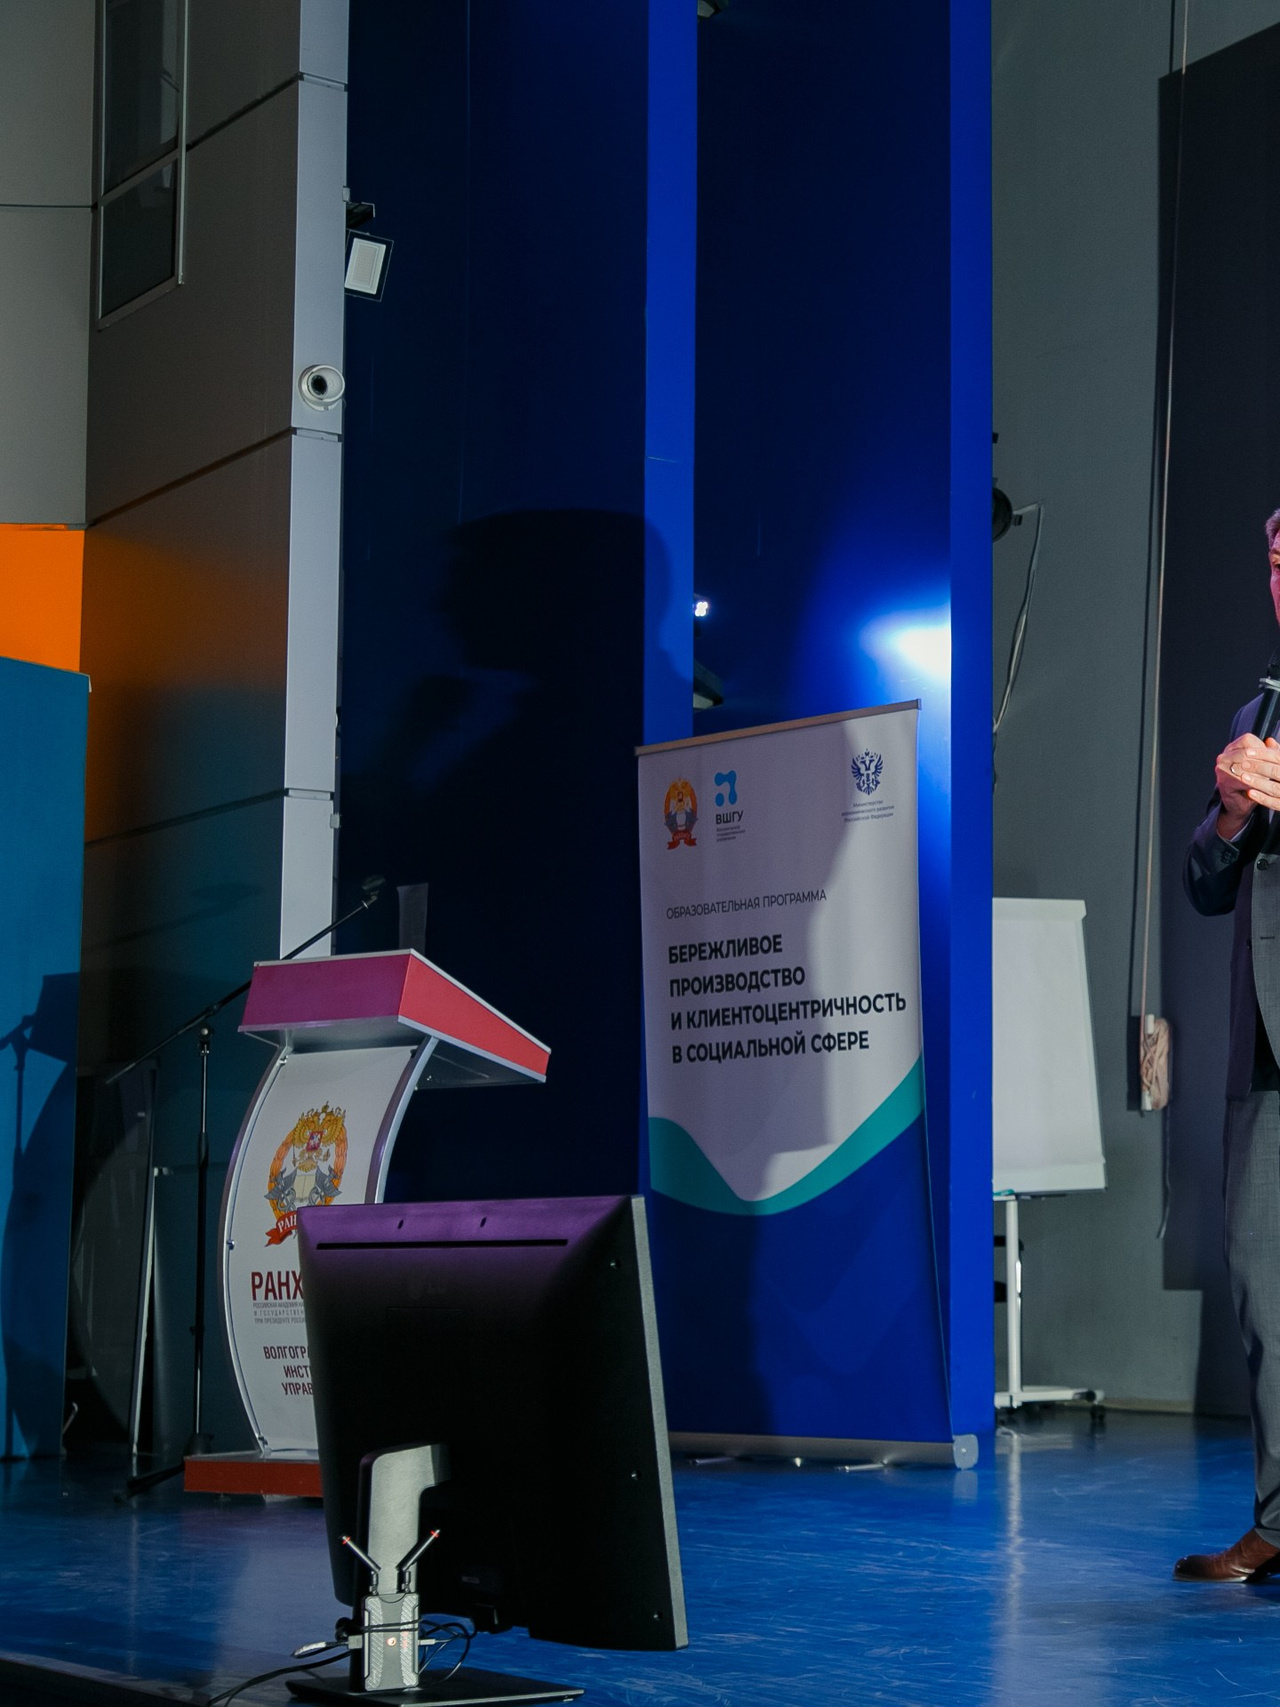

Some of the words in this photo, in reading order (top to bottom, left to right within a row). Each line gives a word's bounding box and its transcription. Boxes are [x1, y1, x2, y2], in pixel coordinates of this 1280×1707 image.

[716, 810, 744, 825] ВШГУ
[666, 897, 760, 919] ОБРАЗОВАТЕЛЬНАЯ
[763, 889, 827, 908] ПРОГРАММА
[668, 934, 783, 964] БЕРЕЖЛИВОЕ
[669, 966, 806, 998] ПРОИЗВОДСТВО
[671, 1012, 682, 1030] И
[686, 992, 907, 1029] КЛИЕНТОЦЕНТРИЧНОСТЬ
[672, 1045, 683, 1064] В
[686, 1031, 805, 1064] СОЦИАЛЬНОЙ
[811, 1030, 870, 1053] СФЕРЕ
[283, 1365, 310, 1378] ИНСТ
